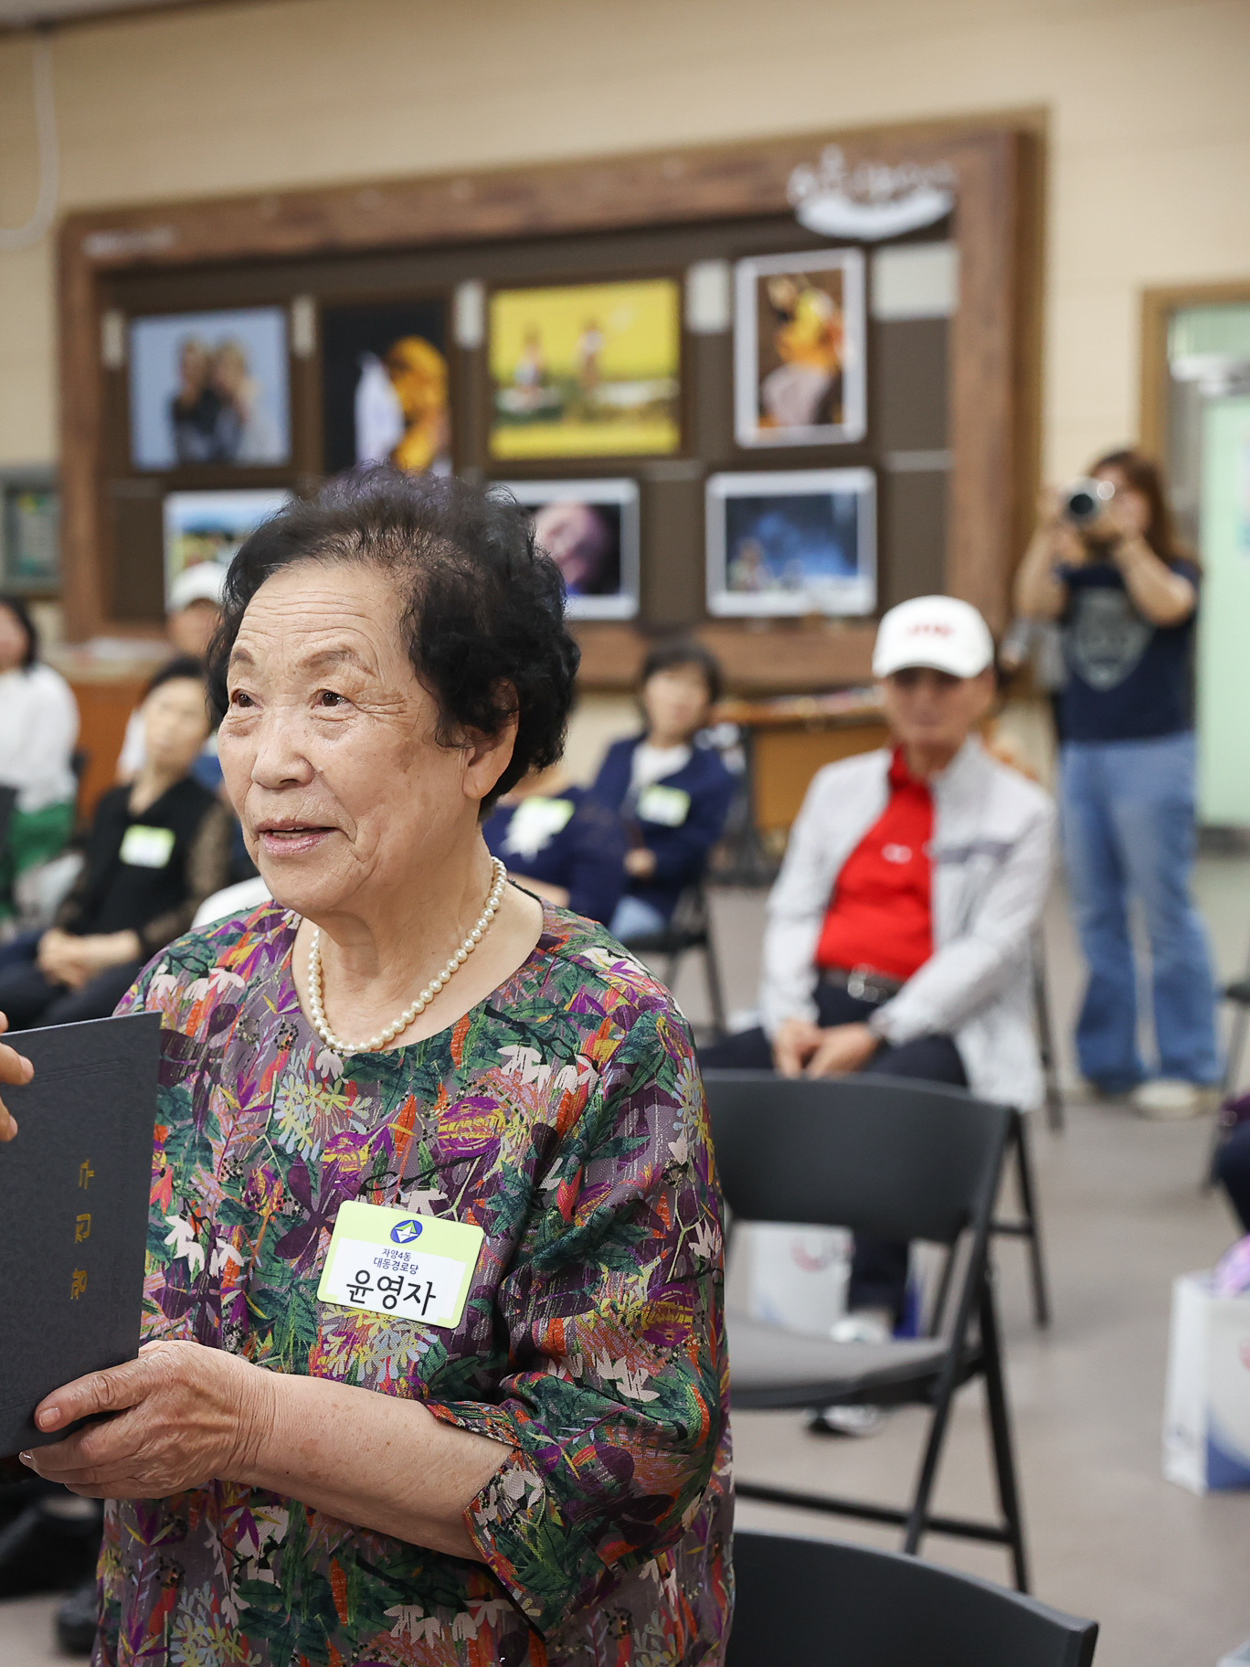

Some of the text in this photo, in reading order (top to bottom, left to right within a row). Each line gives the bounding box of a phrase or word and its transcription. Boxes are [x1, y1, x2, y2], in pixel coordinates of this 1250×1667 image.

[382, 1248, 412, 1262] 자양4동
[373, 1257, 419, 1275] 대동경로당
[346, 1269, 437, 1317] 윤영자
